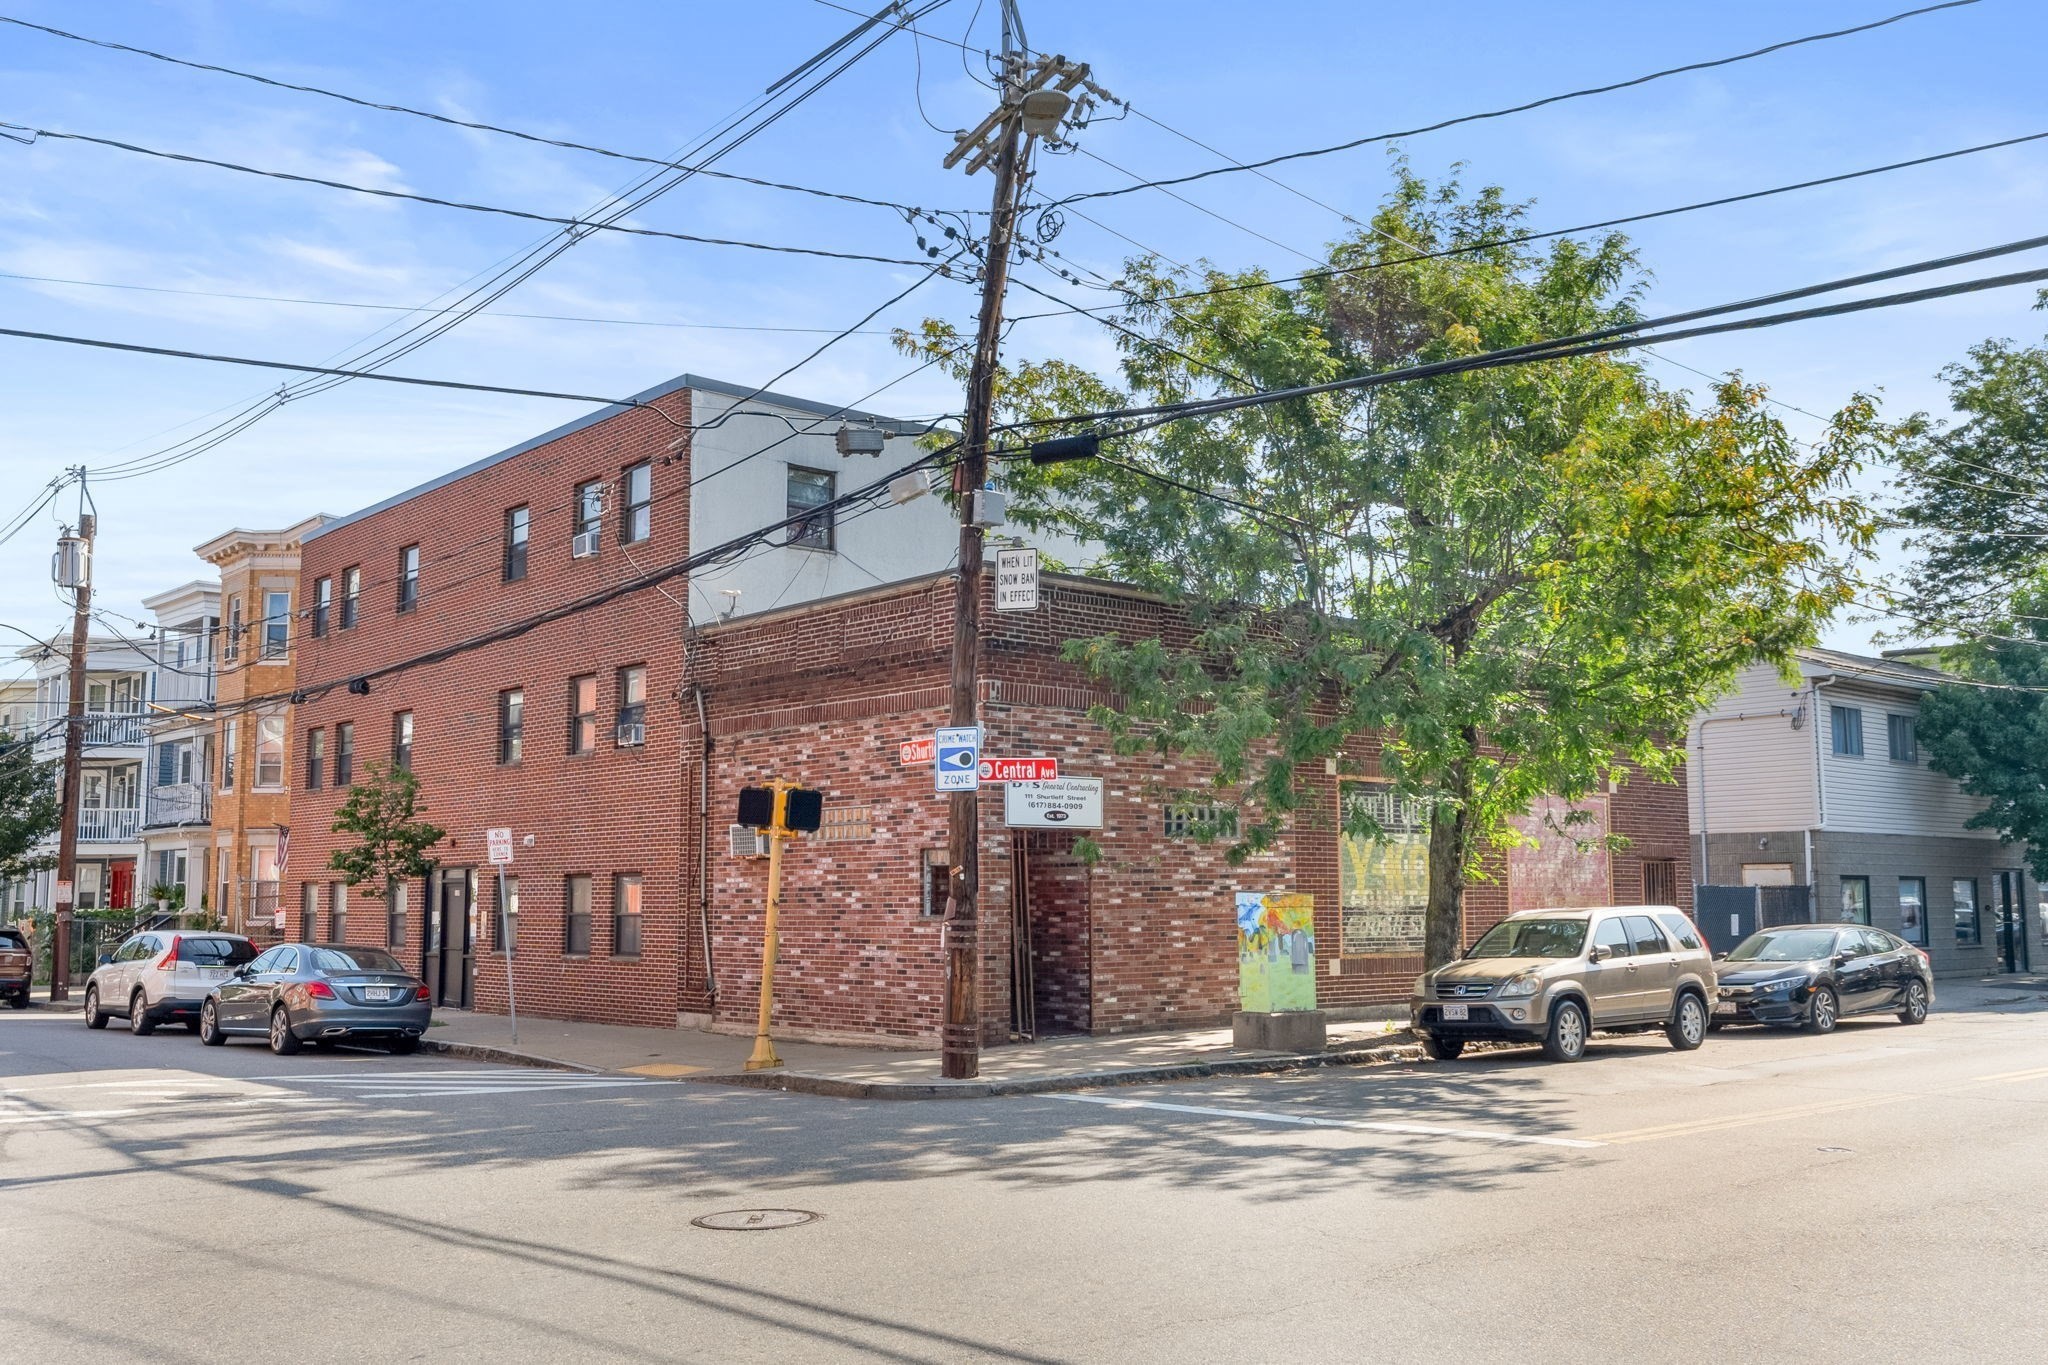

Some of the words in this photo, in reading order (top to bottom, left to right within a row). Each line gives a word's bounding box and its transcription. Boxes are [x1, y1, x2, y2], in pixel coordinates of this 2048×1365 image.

[1001, 555, 1020, 568] WHEN
[1023, 555, 1033, 567] LIT
[1000, 573, 1018, 585] SNOW
[1021, 573, 1035, 584] BAN
[1000, 591, 1007, 602] IN
[1010, 590, 1034, 602] EFFECT
[939, 734, 955, 744] CRIME
[958, 733, 976, 743] WATCH
[995, 761, 1036, 779] Central
[1041, 767, 1055, 779] Ave
[944, 775, 970, 785] ZONE
[1042, 781, 1065, 791] General
[1067, 781, 1099, 795] Contracting
